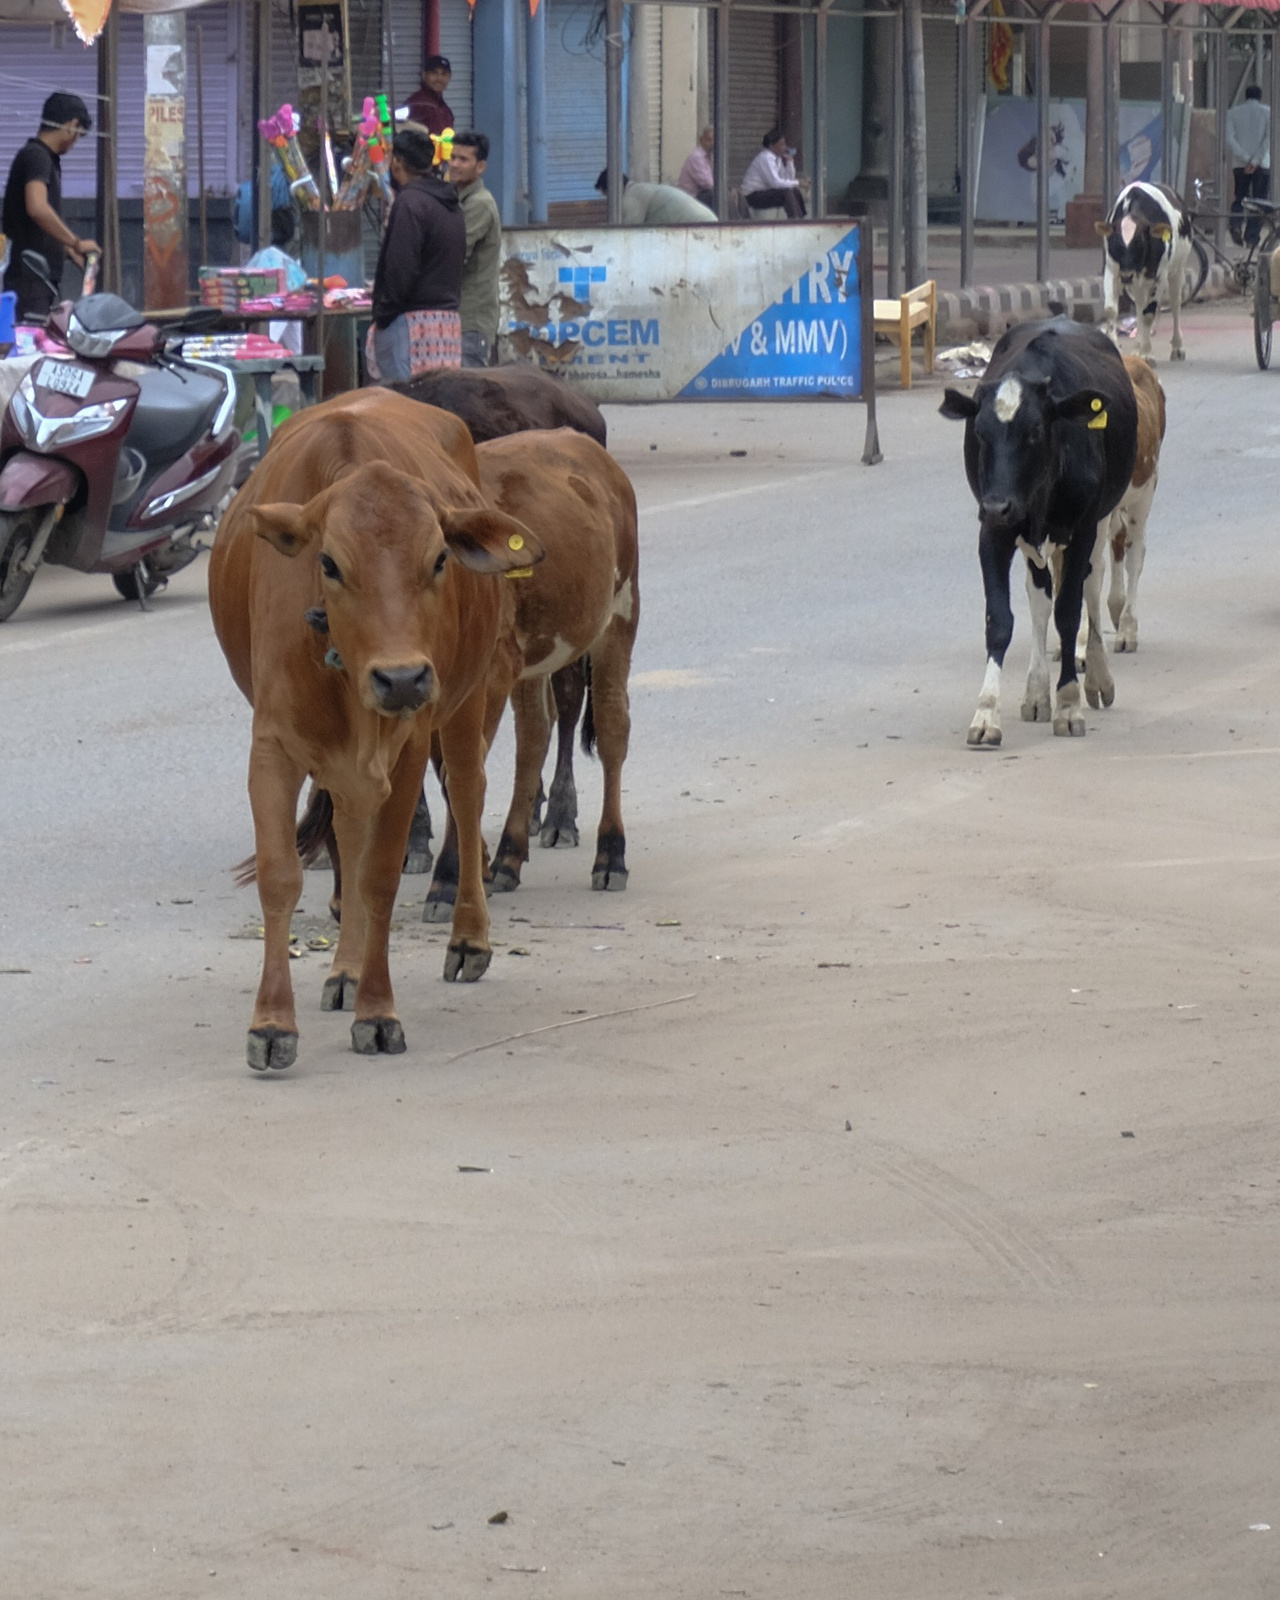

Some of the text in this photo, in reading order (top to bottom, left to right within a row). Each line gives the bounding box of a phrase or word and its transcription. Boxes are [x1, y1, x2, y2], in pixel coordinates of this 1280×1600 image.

[750, 319, 768, 356] &
[775, 319, 847, 361] MMV)
[711, 378, 770, 390] DIBRUGARH
[773, 376, 815, 388] TRAFFIC
